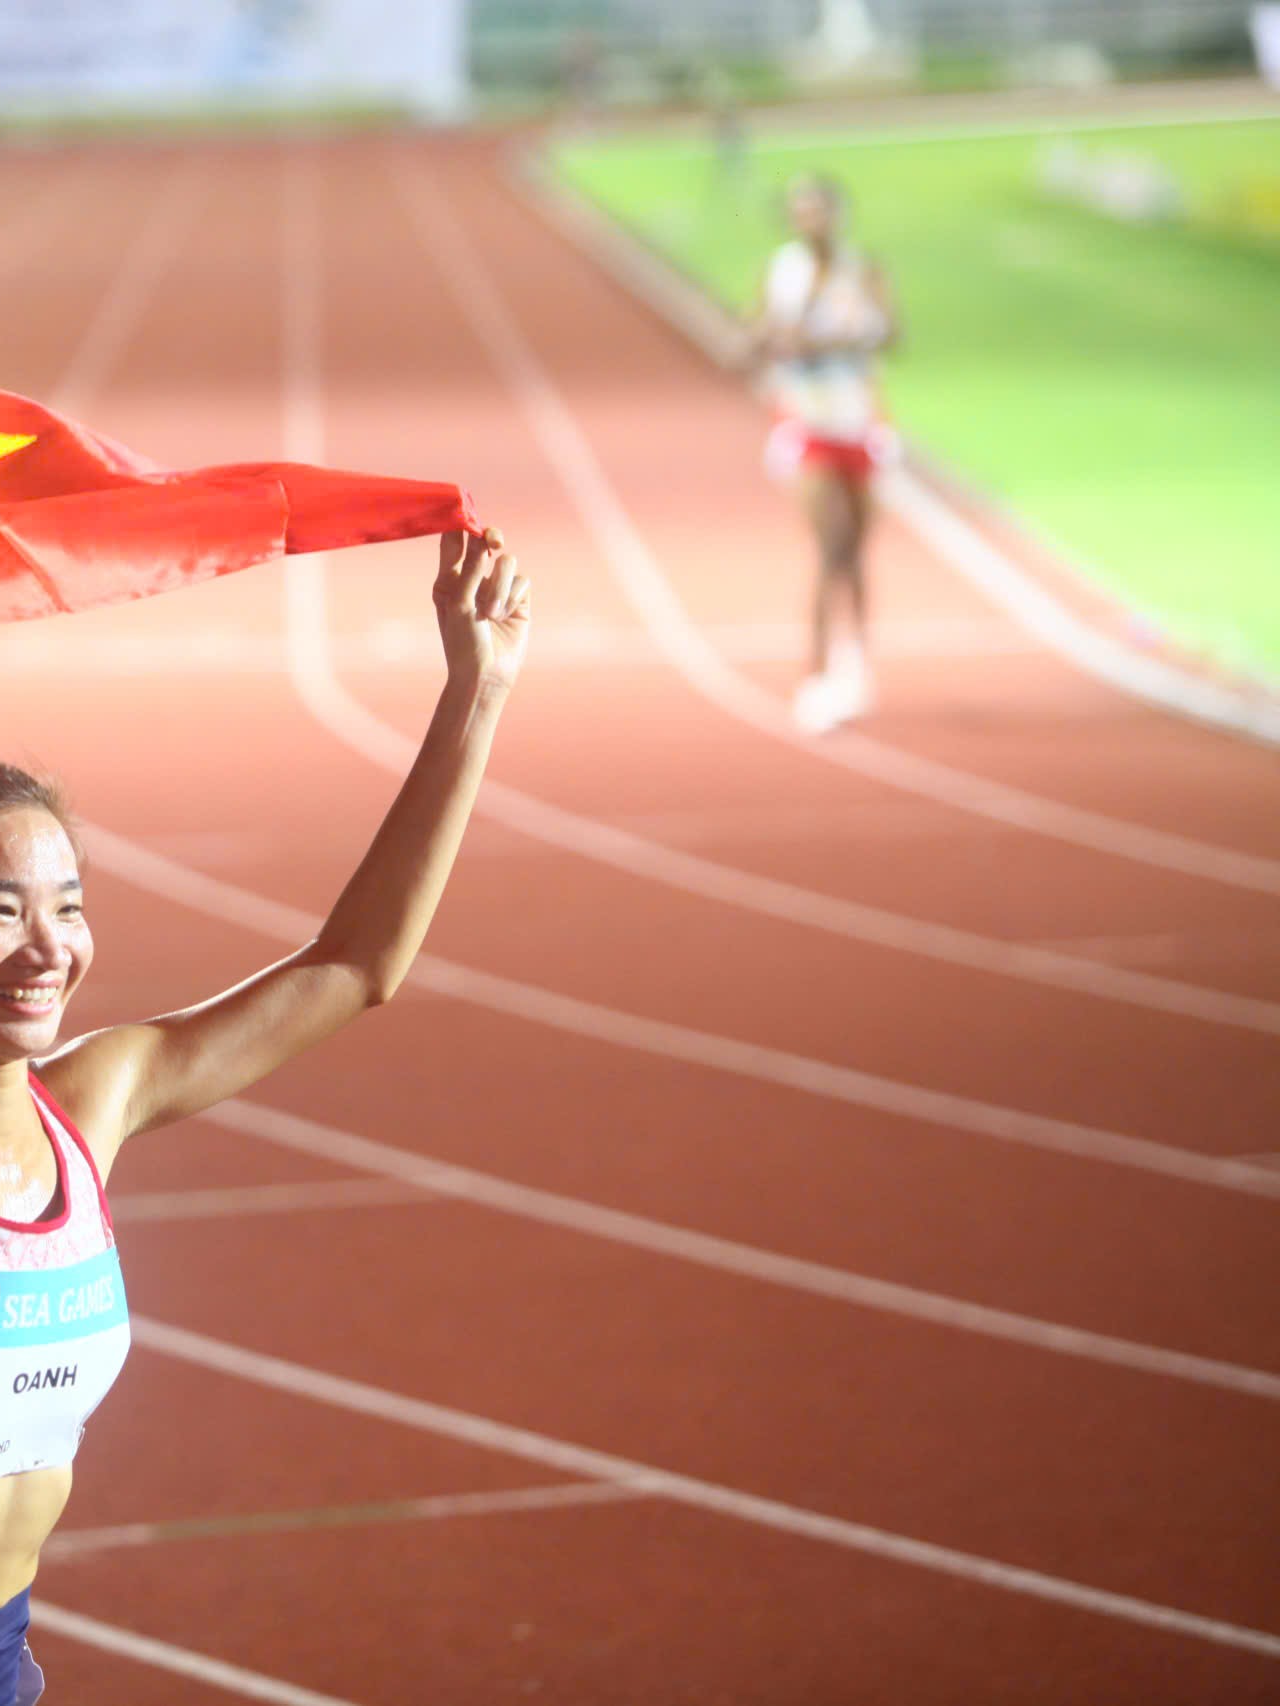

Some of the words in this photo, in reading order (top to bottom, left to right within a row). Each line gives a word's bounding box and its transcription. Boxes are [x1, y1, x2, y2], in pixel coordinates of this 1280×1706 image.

[2, 1293, 51, 1329] SEA
[58, 1274, 115, 1323] GAMES
[13, 1364, 78, 1394] OANH
